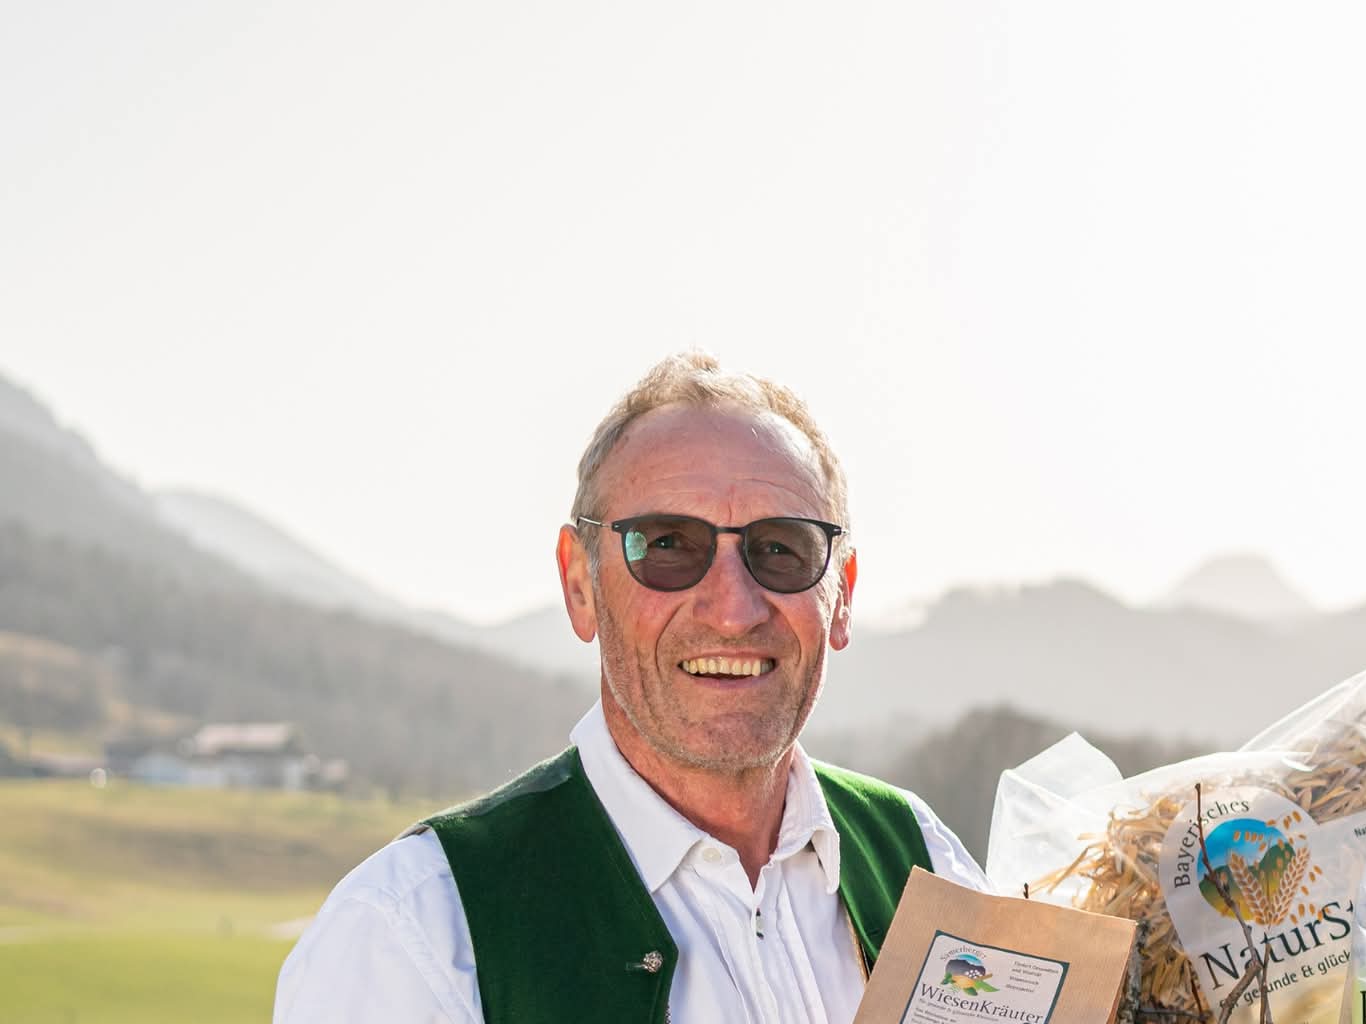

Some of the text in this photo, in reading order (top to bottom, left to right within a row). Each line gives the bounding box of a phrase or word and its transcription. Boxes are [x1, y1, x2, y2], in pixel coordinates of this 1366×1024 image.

[921, 983, 1043, 1024] WiesenKräuter
[1243, 972, 1298, 1006] geunde
[1301, 965, 1314, 978] &
